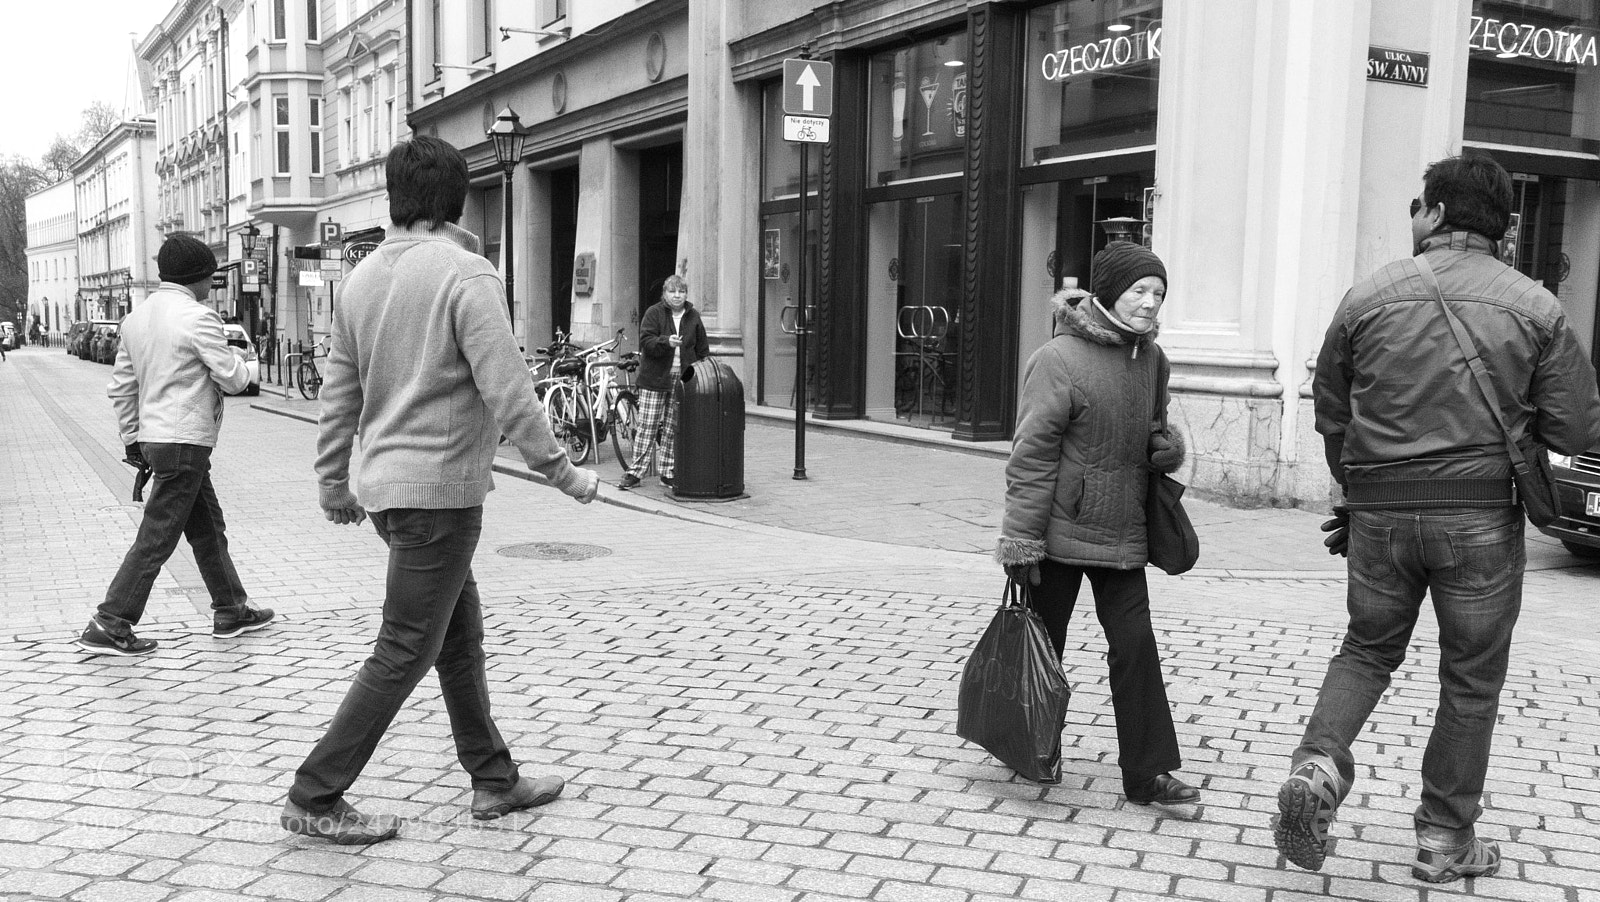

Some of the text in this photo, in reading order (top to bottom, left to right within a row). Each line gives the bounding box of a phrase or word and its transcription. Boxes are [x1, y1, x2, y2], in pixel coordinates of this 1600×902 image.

[1384, 51, 1412, 62] ULICA
[1389, 63, 1428, 83] ANNY
[802, 118, 824, 127] dotyczy
[324, 224, 338, 242] P
[244, 261, 255, 274] P
